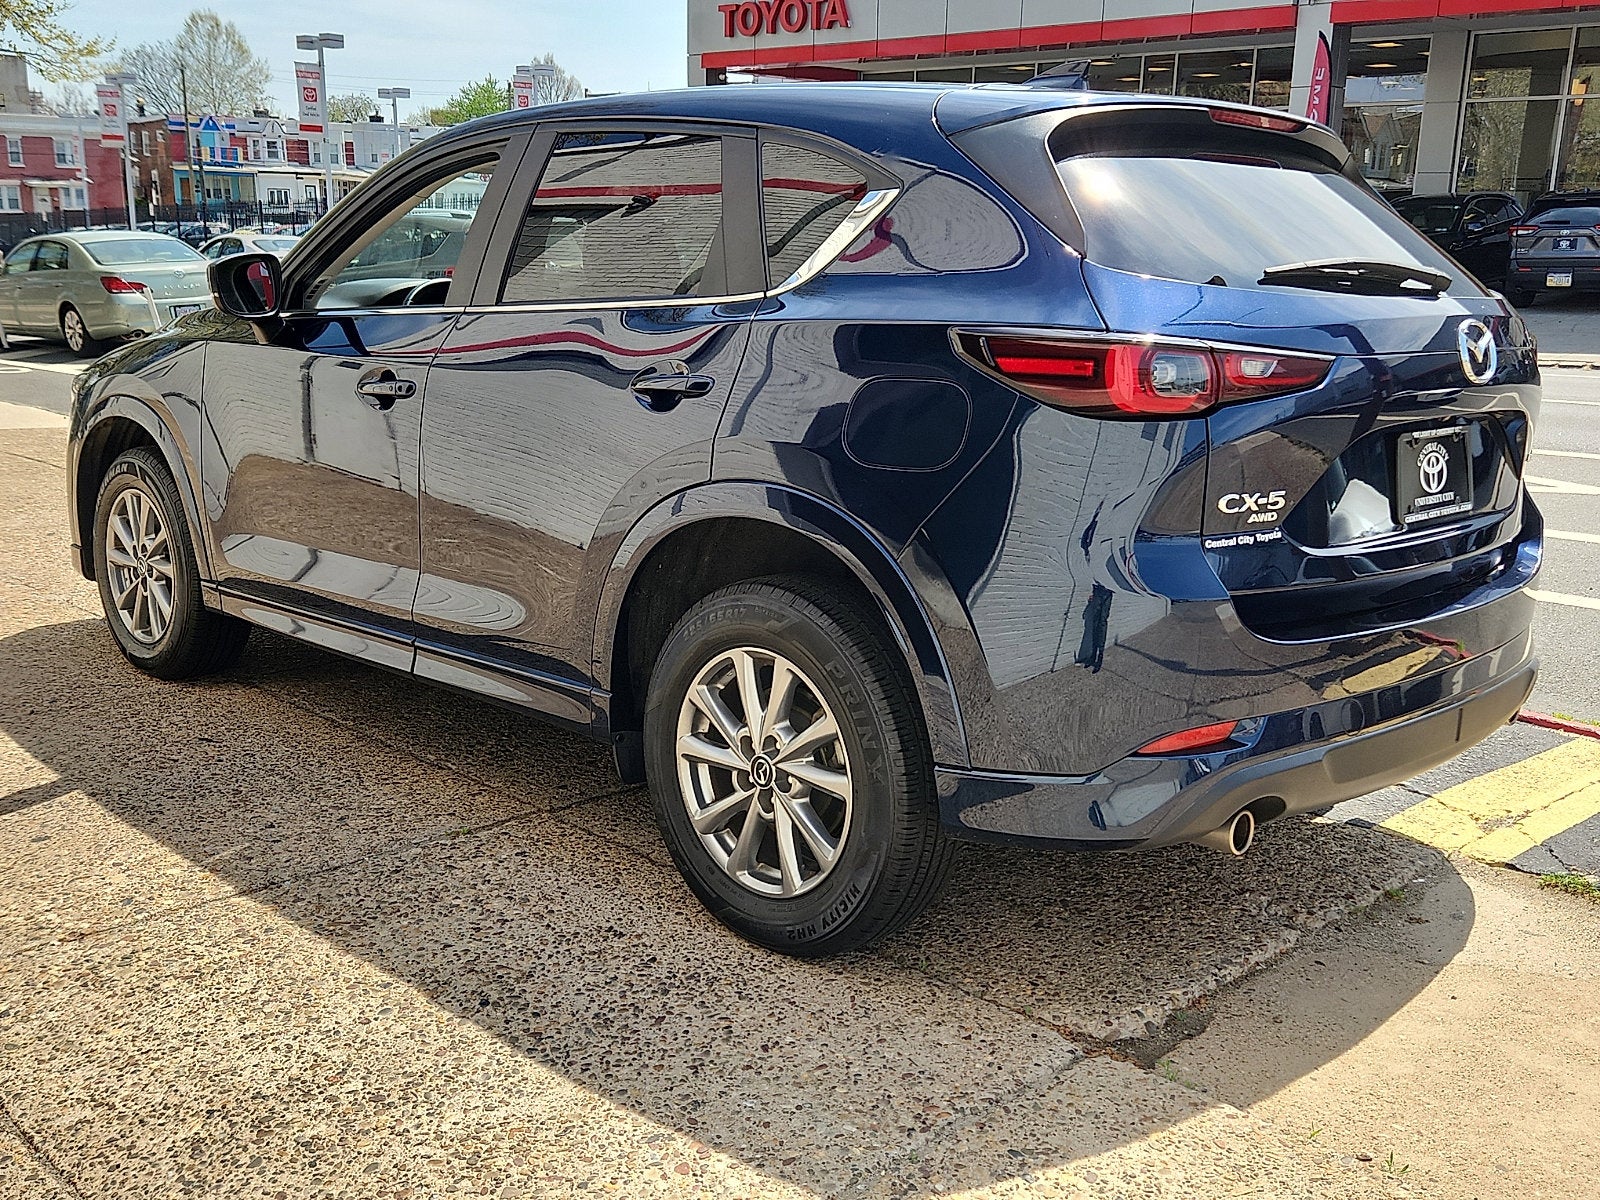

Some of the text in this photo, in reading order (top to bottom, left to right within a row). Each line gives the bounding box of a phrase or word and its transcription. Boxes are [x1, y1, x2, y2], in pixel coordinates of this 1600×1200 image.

[718, 0, 850, 38] TOYOTA
[1217, 490, 1287, 514] CX-5
[1247, 511, 1278, 524] AWD
[1205, 531, 1282, 549] Central City Toyota
